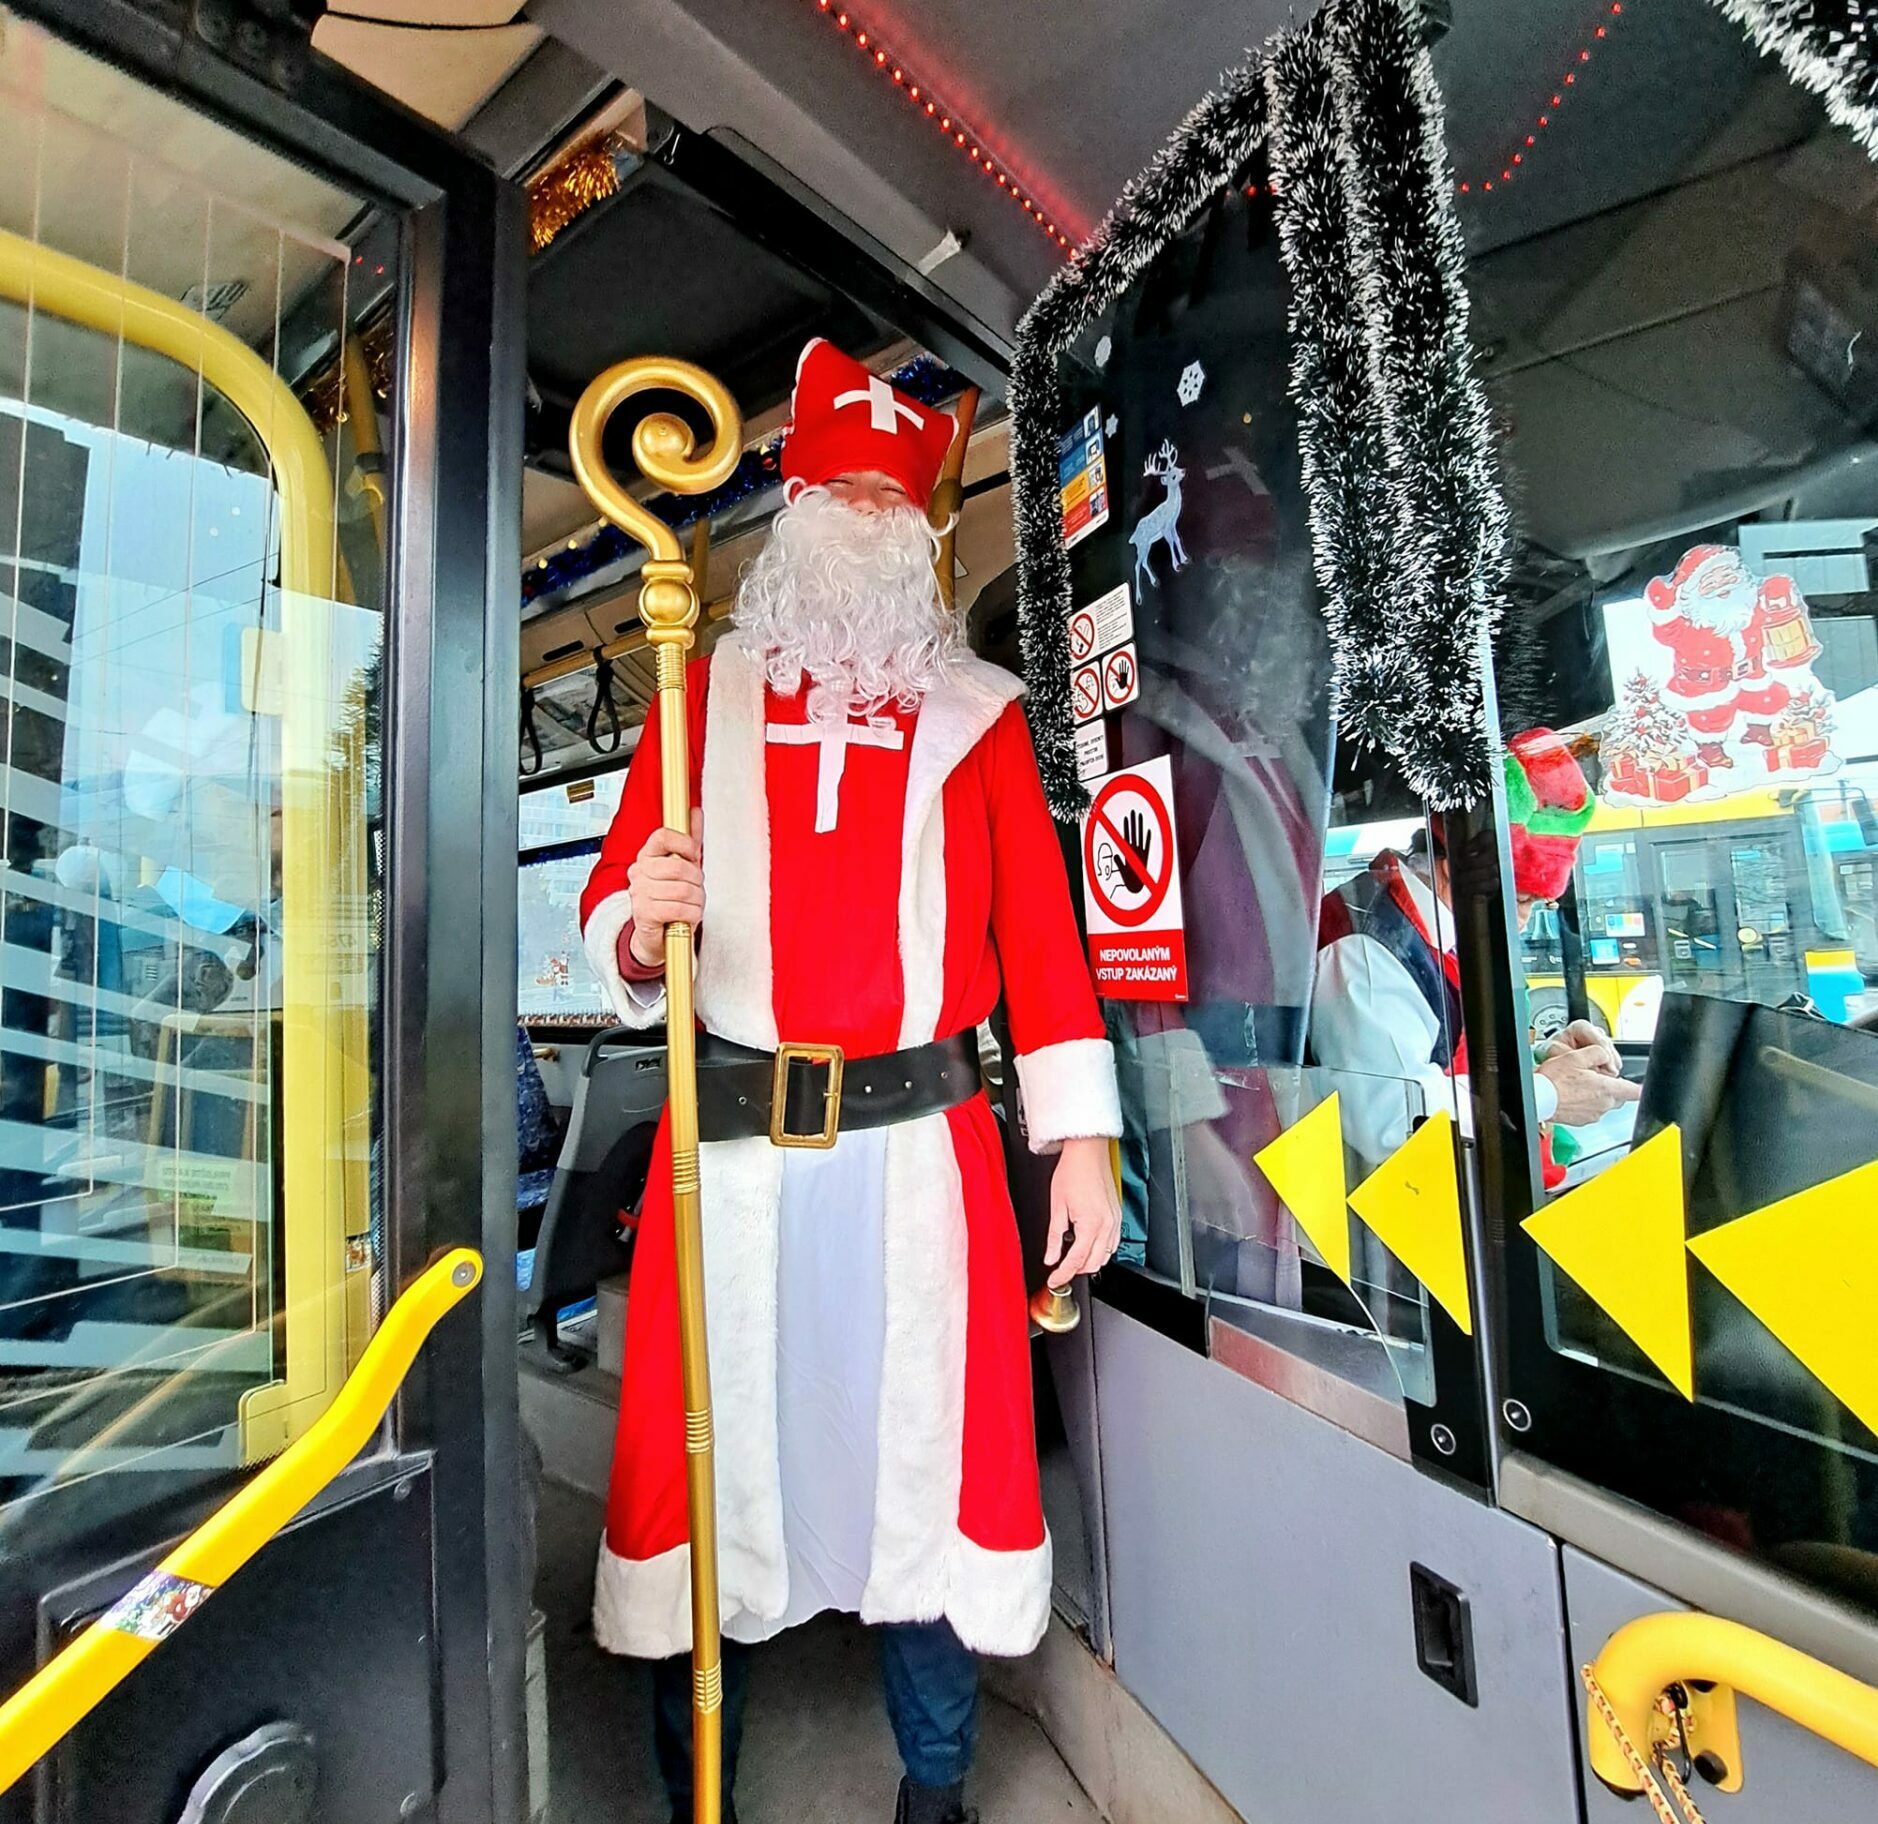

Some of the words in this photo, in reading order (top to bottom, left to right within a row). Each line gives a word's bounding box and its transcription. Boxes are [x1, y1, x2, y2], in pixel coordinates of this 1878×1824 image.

[1099, 945, 1171, 962] NEPOVOLANÝM
[1095, 967, 1124, 981] VSTUP
[1125, 965, 1178, 981] ZAKÁZANÝ
